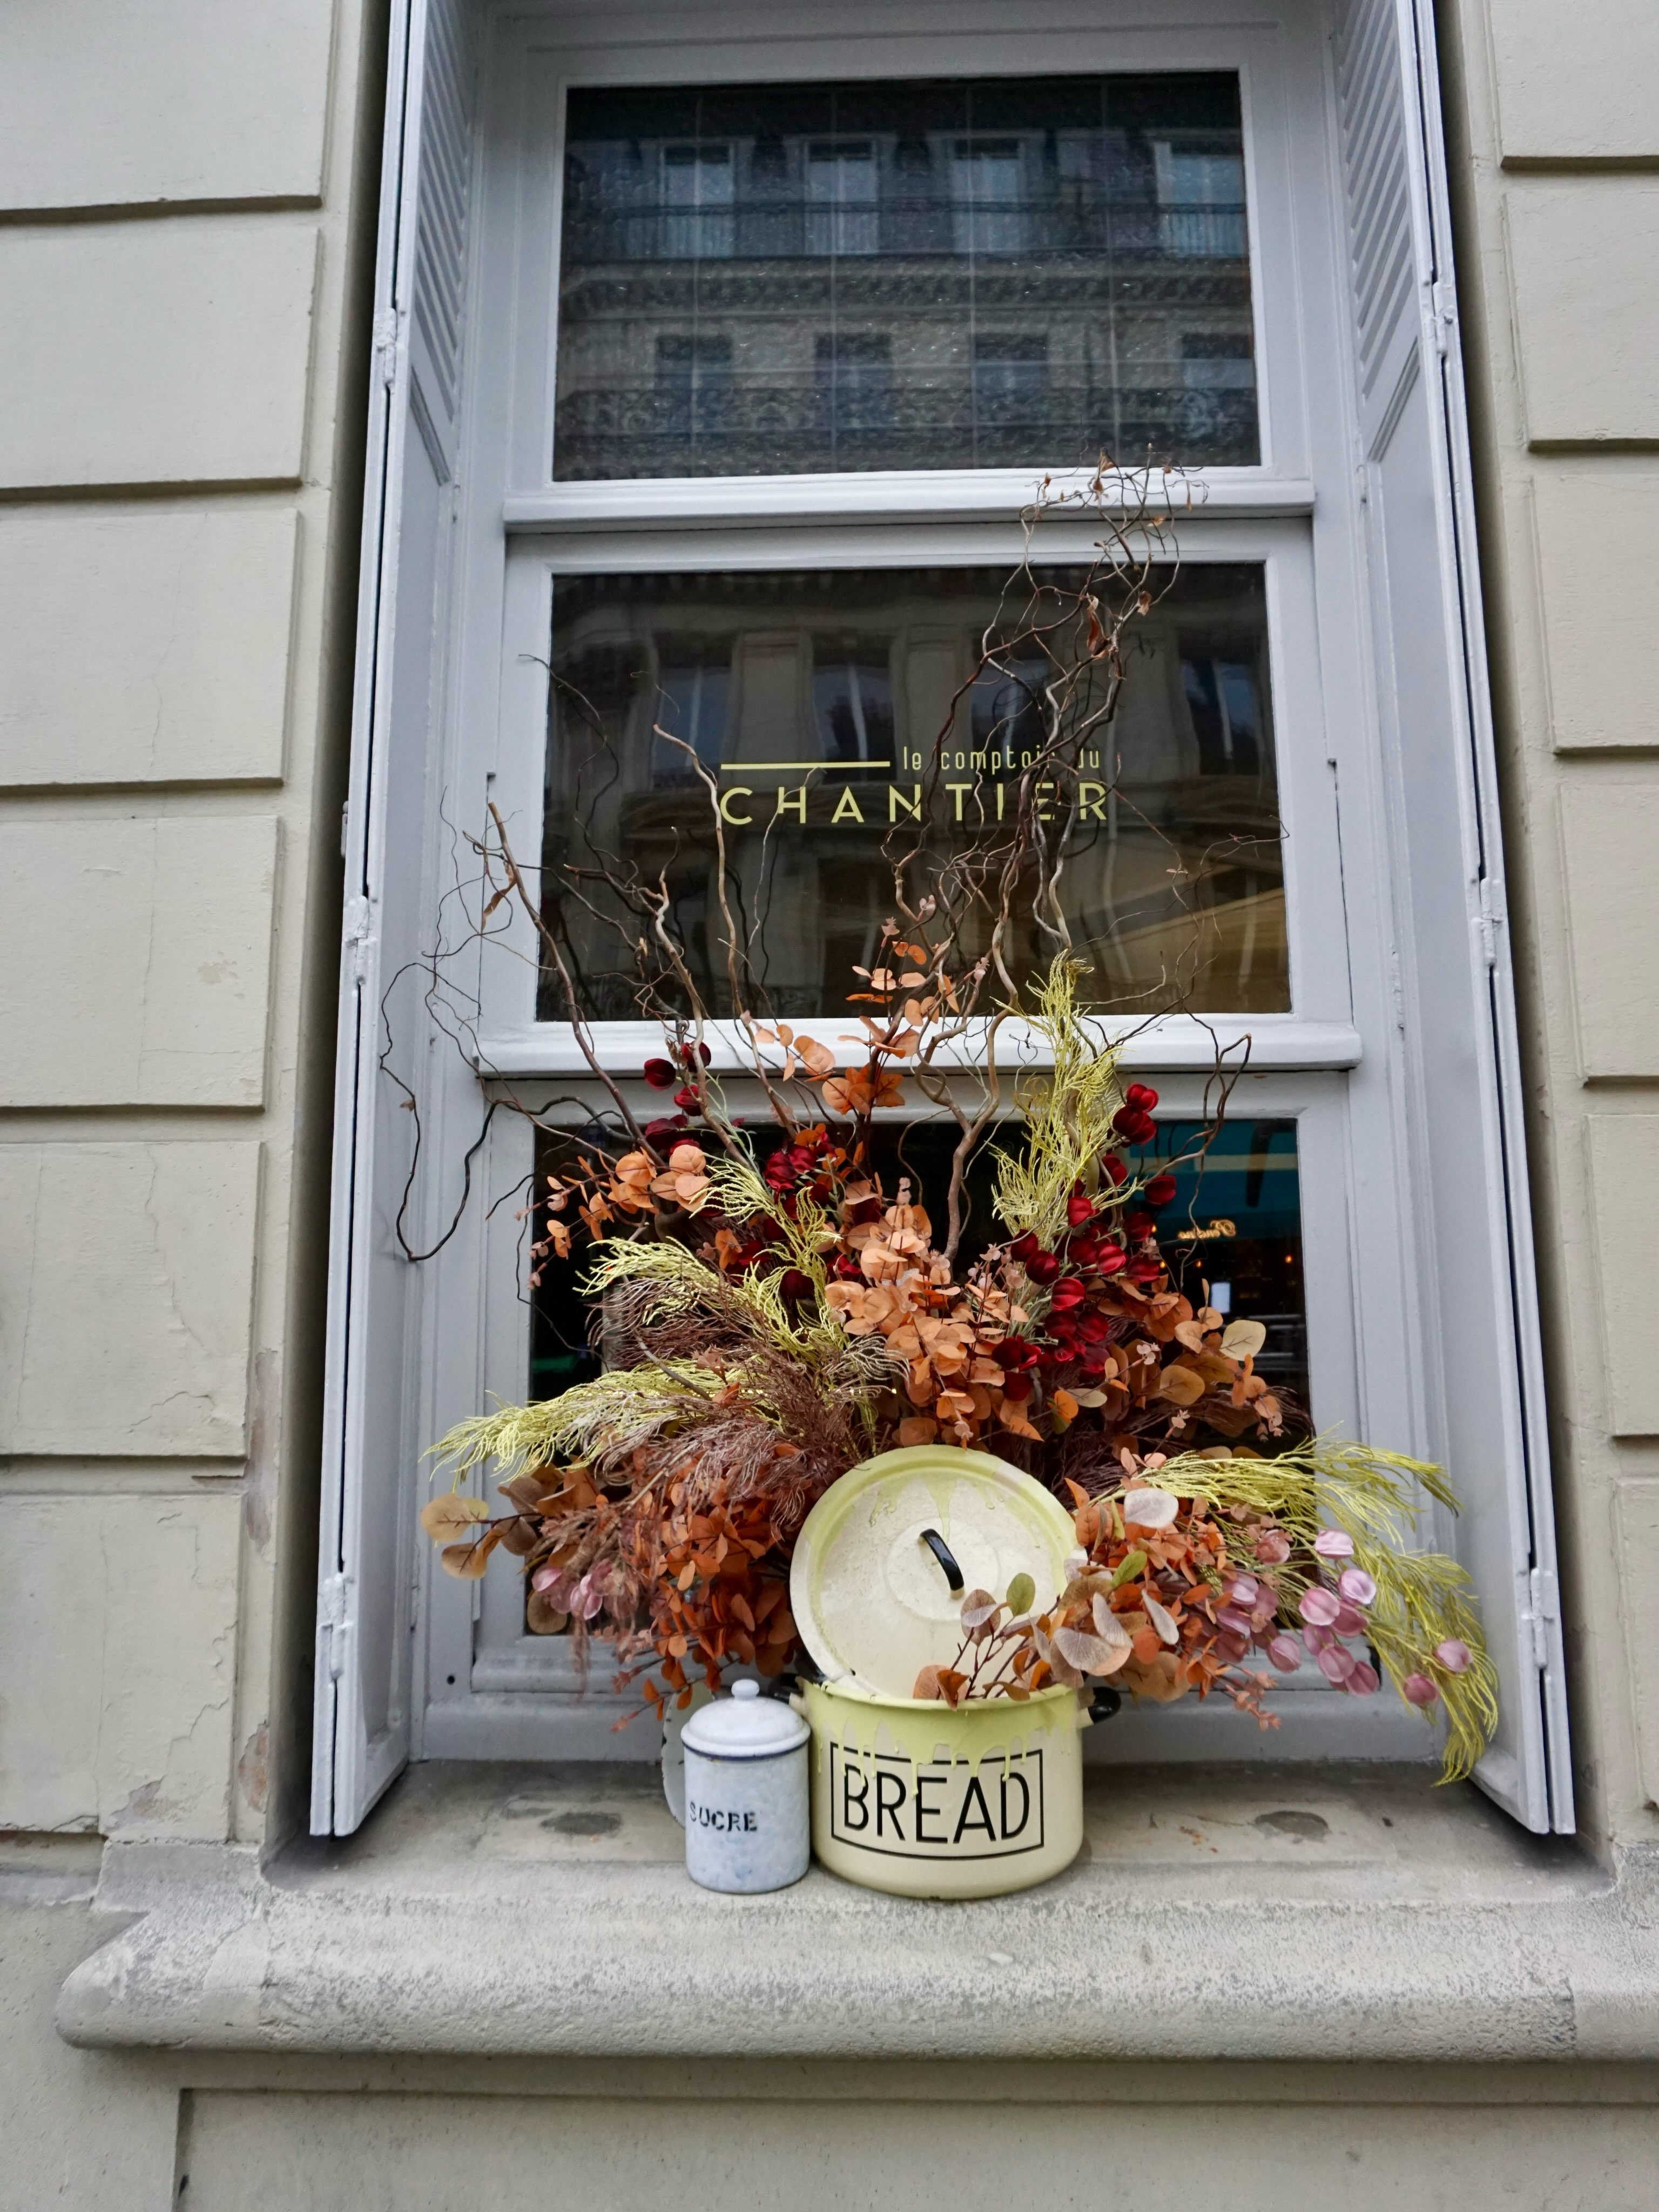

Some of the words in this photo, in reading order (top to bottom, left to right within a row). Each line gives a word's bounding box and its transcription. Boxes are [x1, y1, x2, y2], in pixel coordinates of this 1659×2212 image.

[903, 746, 921, 770] le
[721, 783, 1107, 825] CHANTIER
[690, 1801, 757, 1832] SUCRE
[844, 1764, 1029, 1844] BREAD
